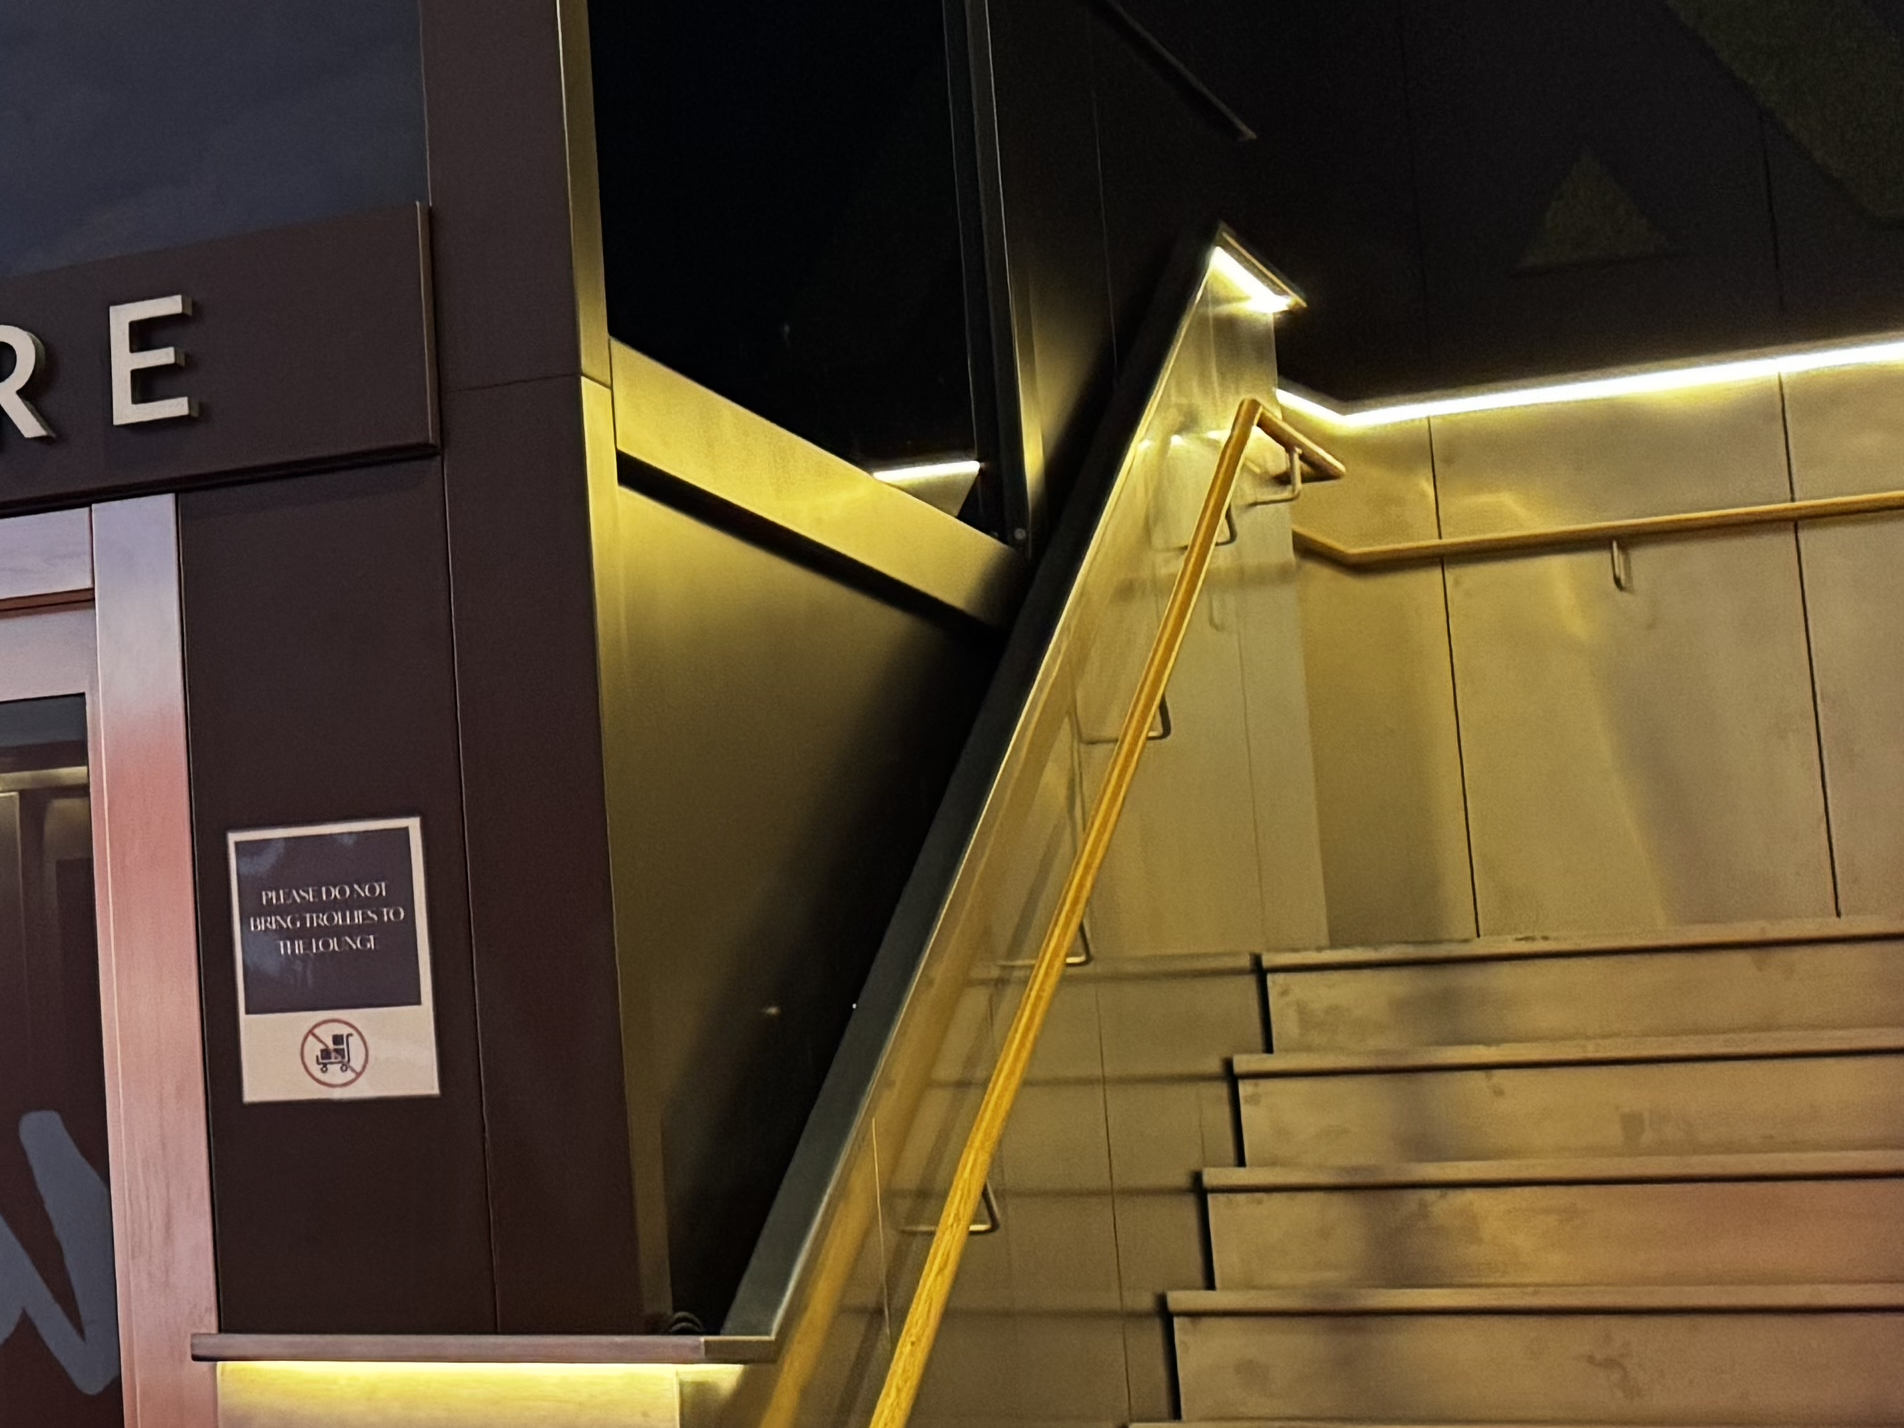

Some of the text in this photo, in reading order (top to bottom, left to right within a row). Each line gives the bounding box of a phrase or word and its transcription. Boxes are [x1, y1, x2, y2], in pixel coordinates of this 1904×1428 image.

[261, 881, 388, 906] PLEASE DO NOT
[250, 906, 405, 932] BRING TROLLIES TO
[277, 933, 379, 956] THE LOUNGE
